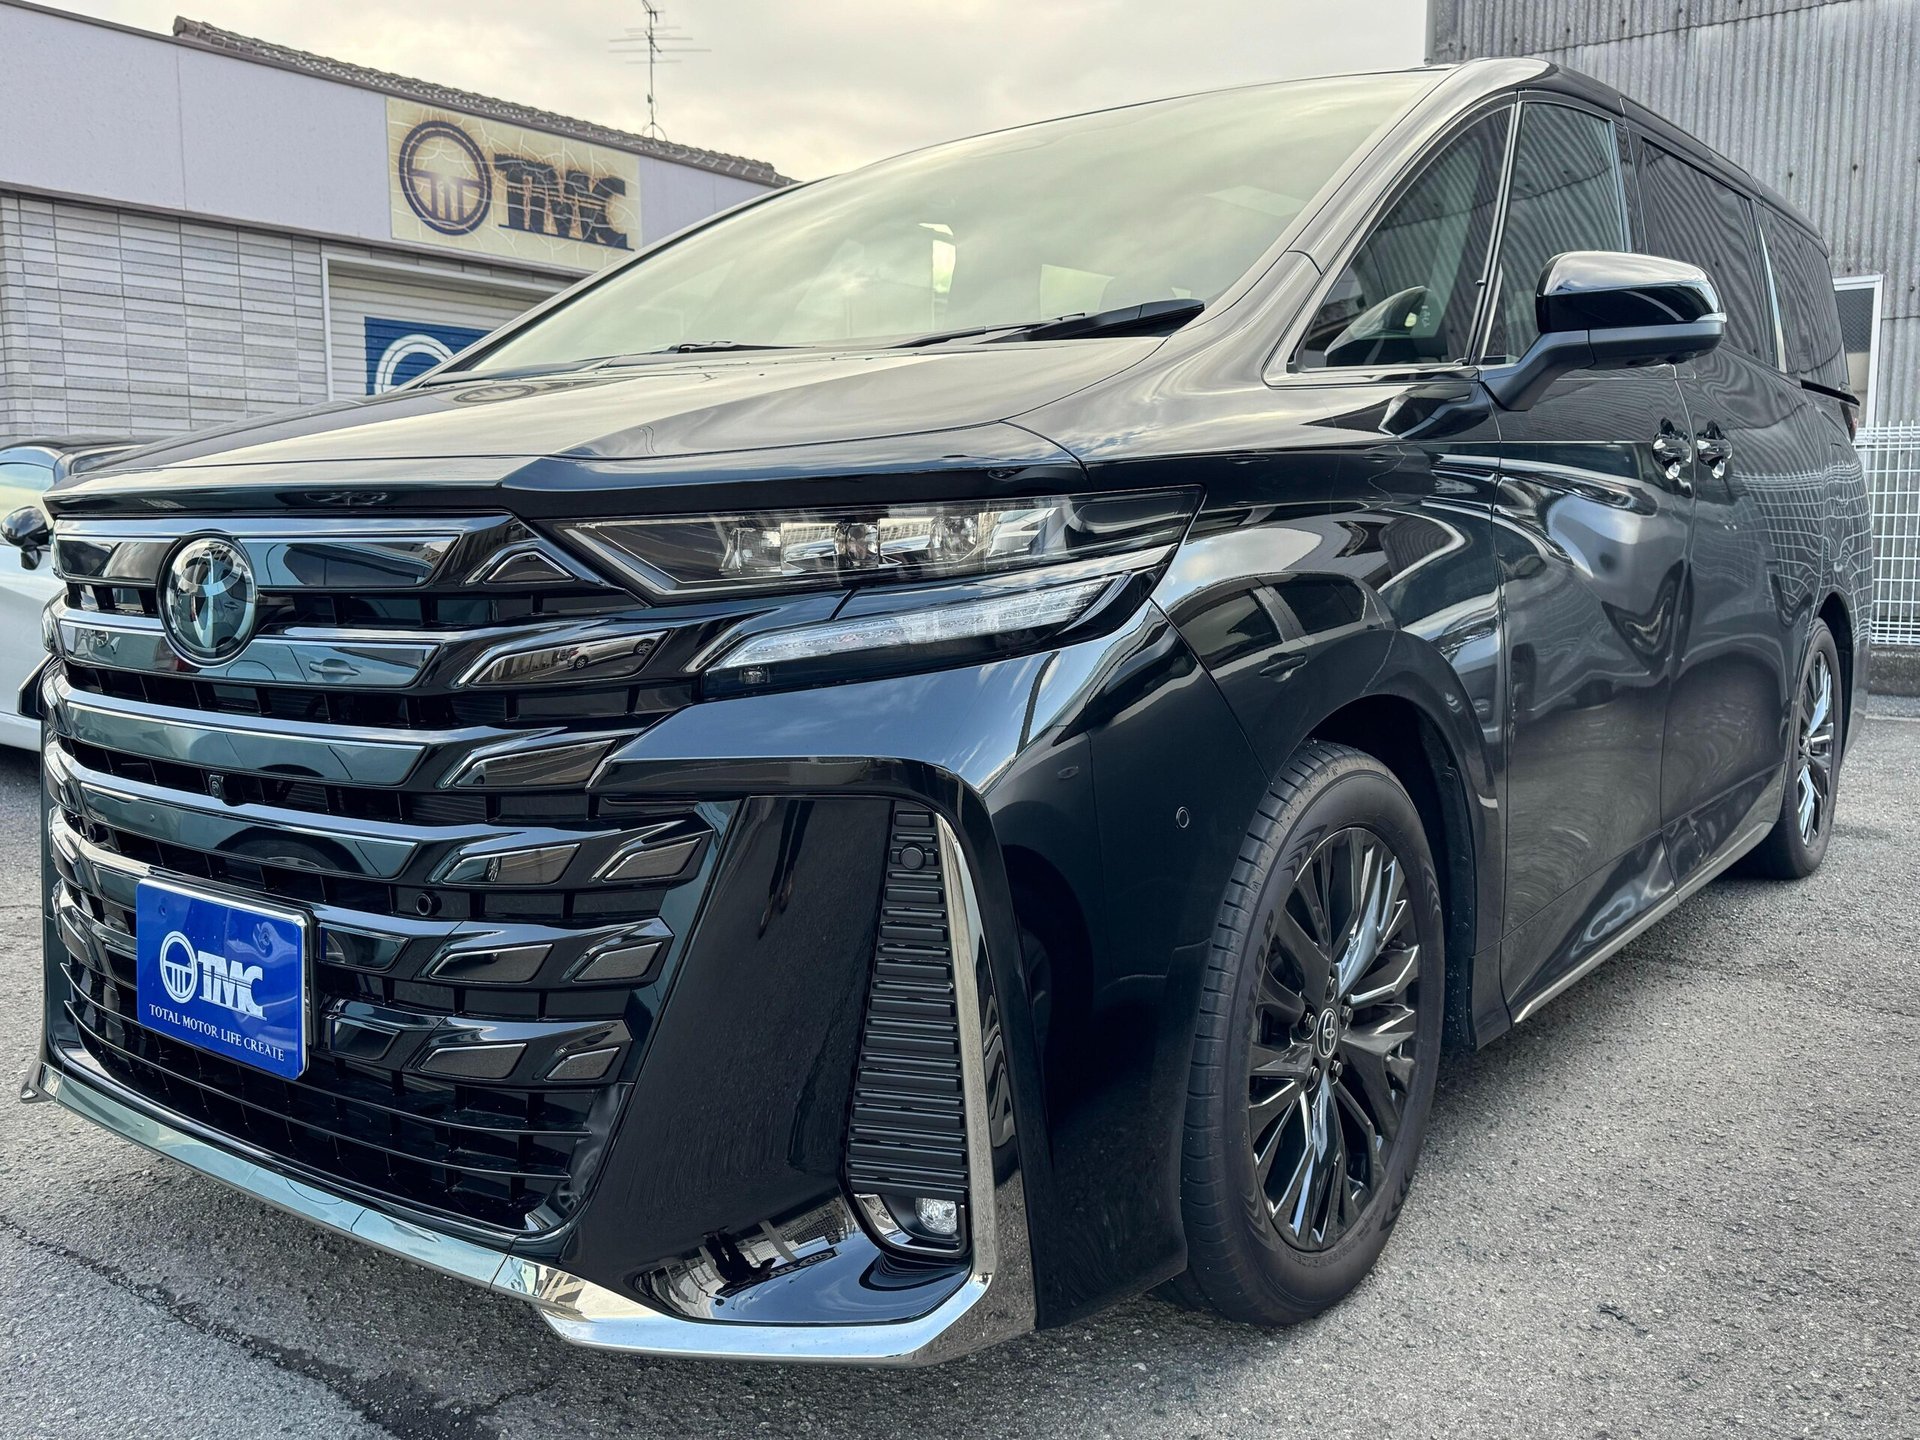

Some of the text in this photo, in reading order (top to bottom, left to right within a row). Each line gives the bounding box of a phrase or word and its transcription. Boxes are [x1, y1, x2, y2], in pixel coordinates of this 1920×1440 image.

[495, 153, 635, 251] TMC
[198, 950, 267, 1021] TMC
[149, 1003, 285, 1062] TOTAL MOTOR LIFE CREATE
